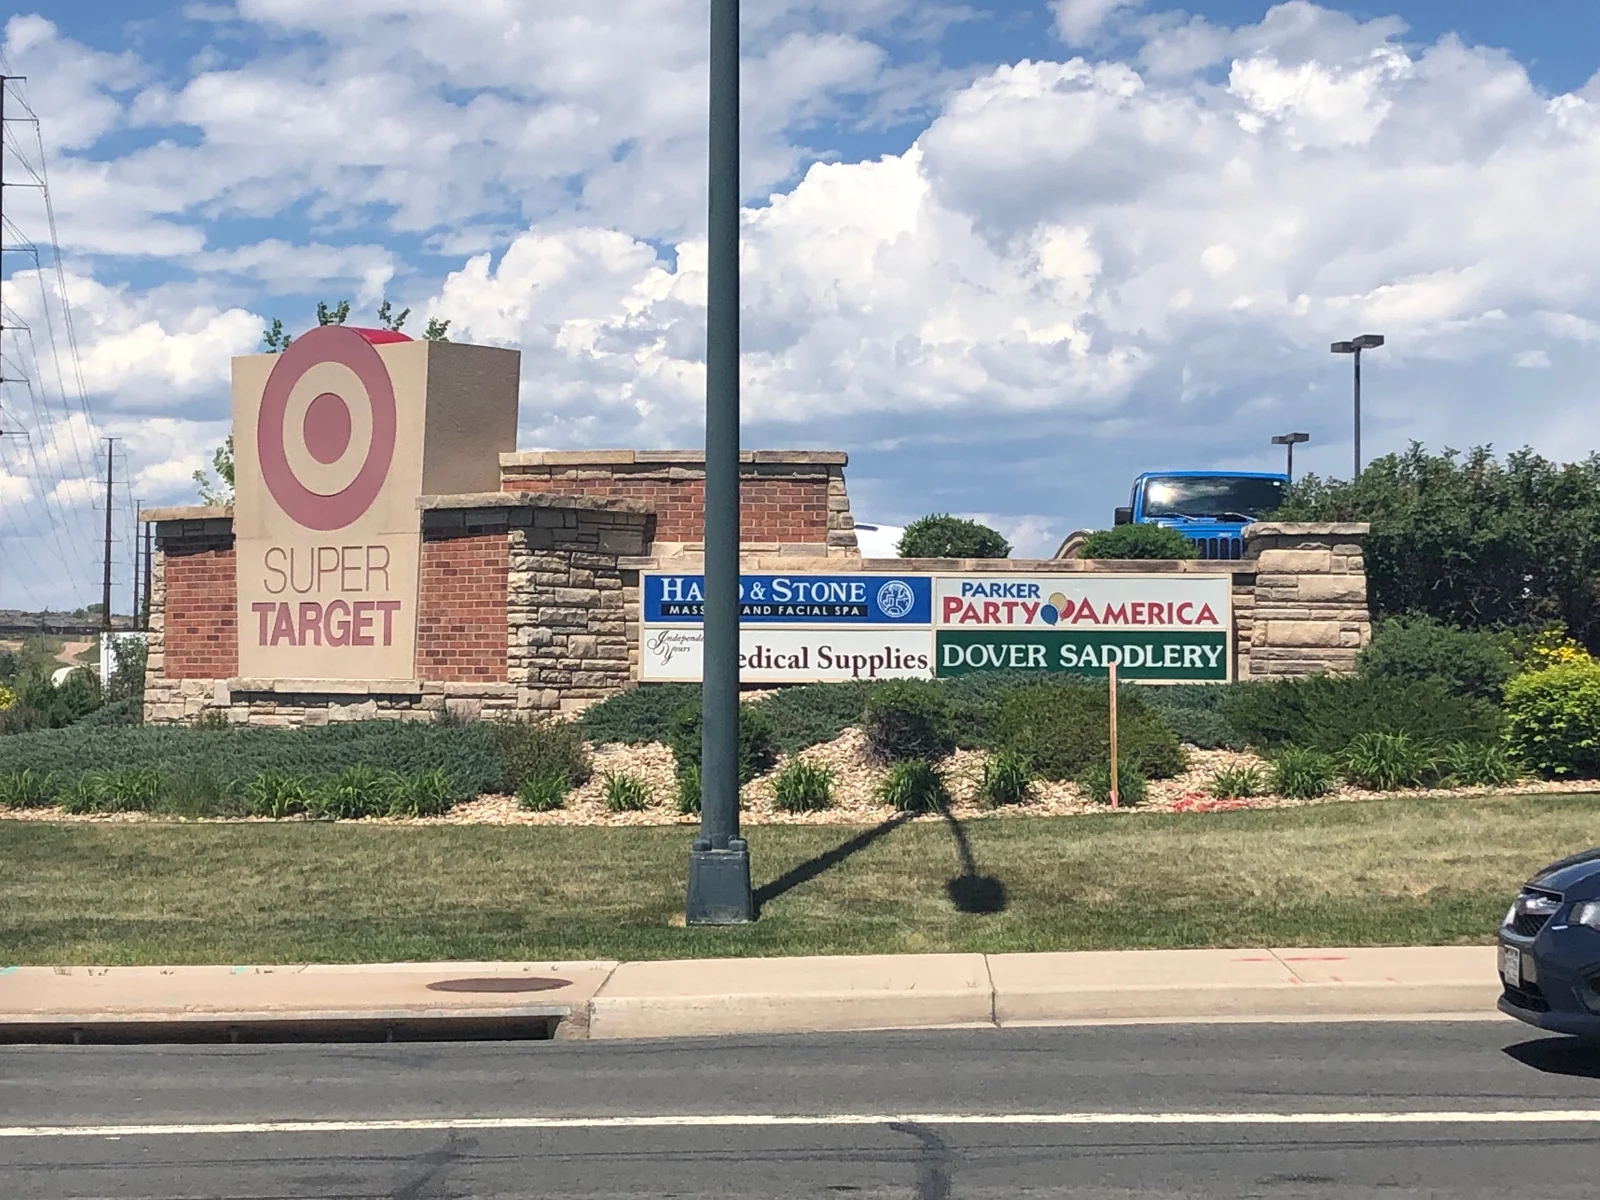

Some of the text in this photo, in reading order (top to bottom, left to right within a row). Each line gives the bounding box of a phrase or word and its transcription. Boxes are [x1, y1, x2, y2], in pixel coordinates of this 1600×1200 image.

[263, 545, 390, 594] SUPER
[661, 578, 867, 602] HA & STONE
[961, 582, 1041, 599] PARKER
[669, 605, 860, 616] MASS AND FACIAL SPA
[943, 596, 1219, 625] PARTY AMERICA
[251, 599, 401, 648] TARGET
[653, 641, 691, 666] Yours
[739, 645, 928, 678] edical Supplies
[942, 643, 1223, 668] DOVER SADDLERY
